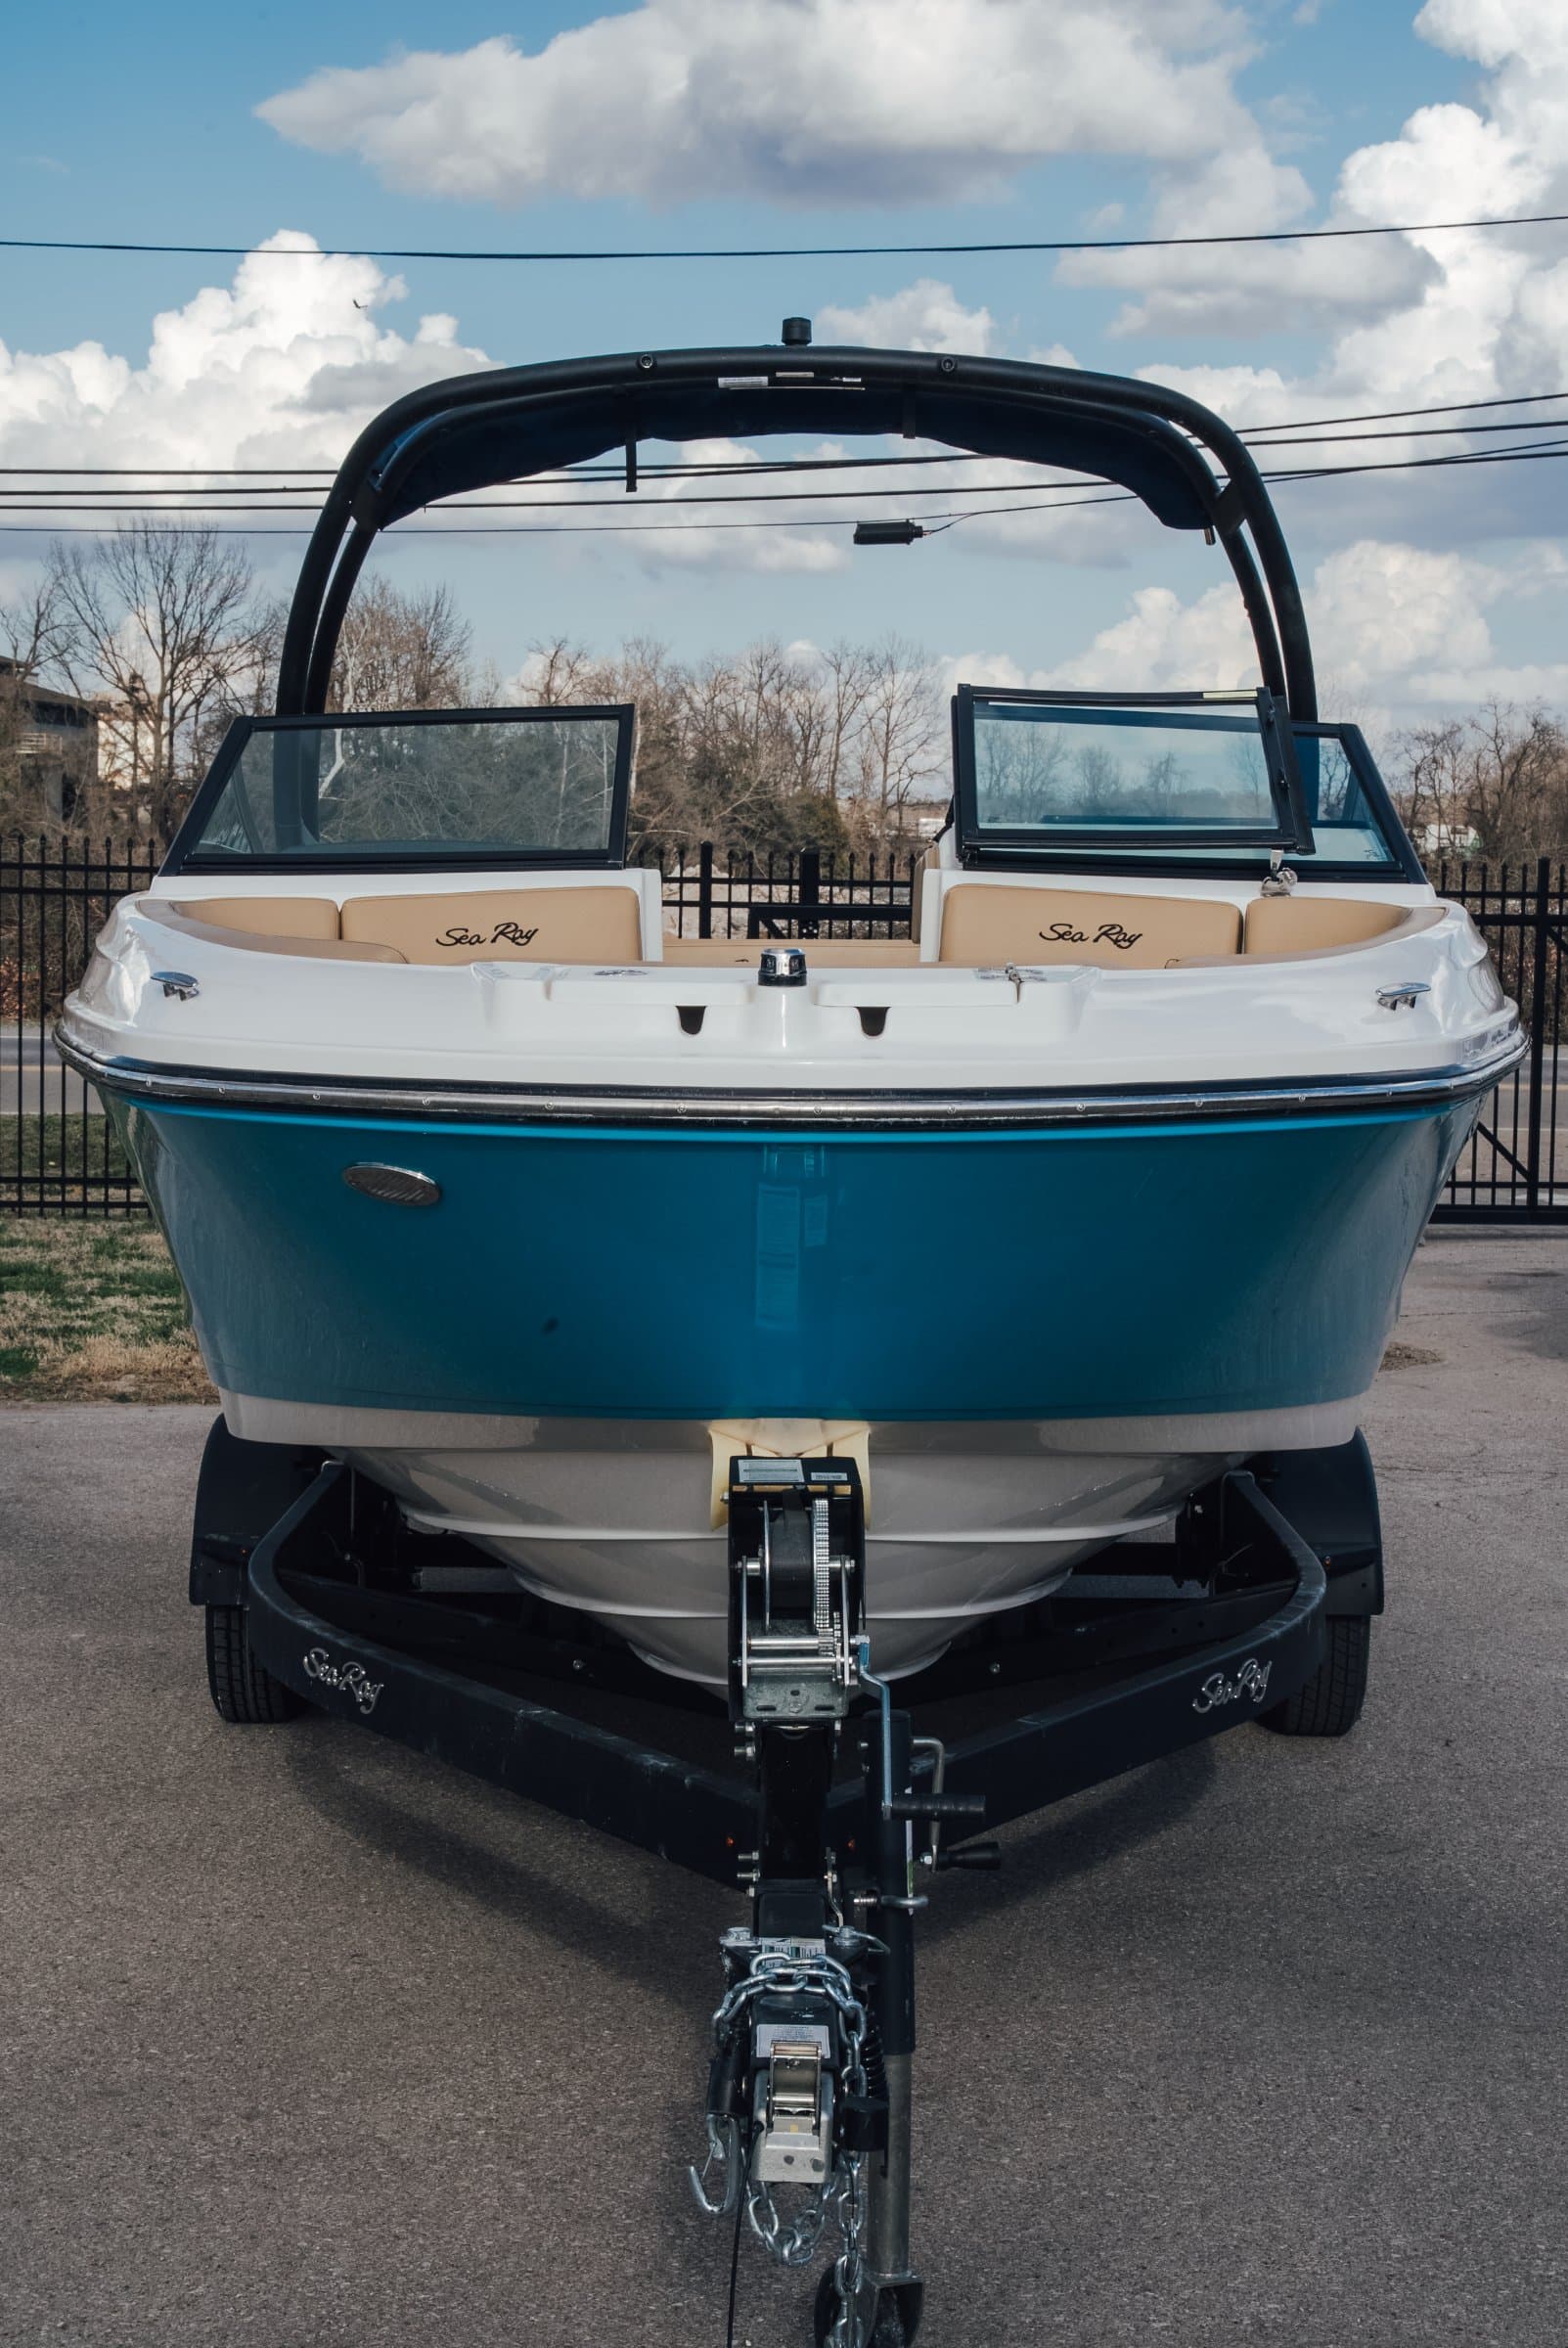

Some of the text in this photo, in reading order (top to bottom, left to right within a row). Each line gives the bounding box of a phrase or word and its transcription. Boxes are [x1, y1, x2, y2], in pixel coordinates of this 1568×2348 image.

[435, 922, 539, 946] Sea Ray
[1039, 923, 1142, 949] Sea Ray
